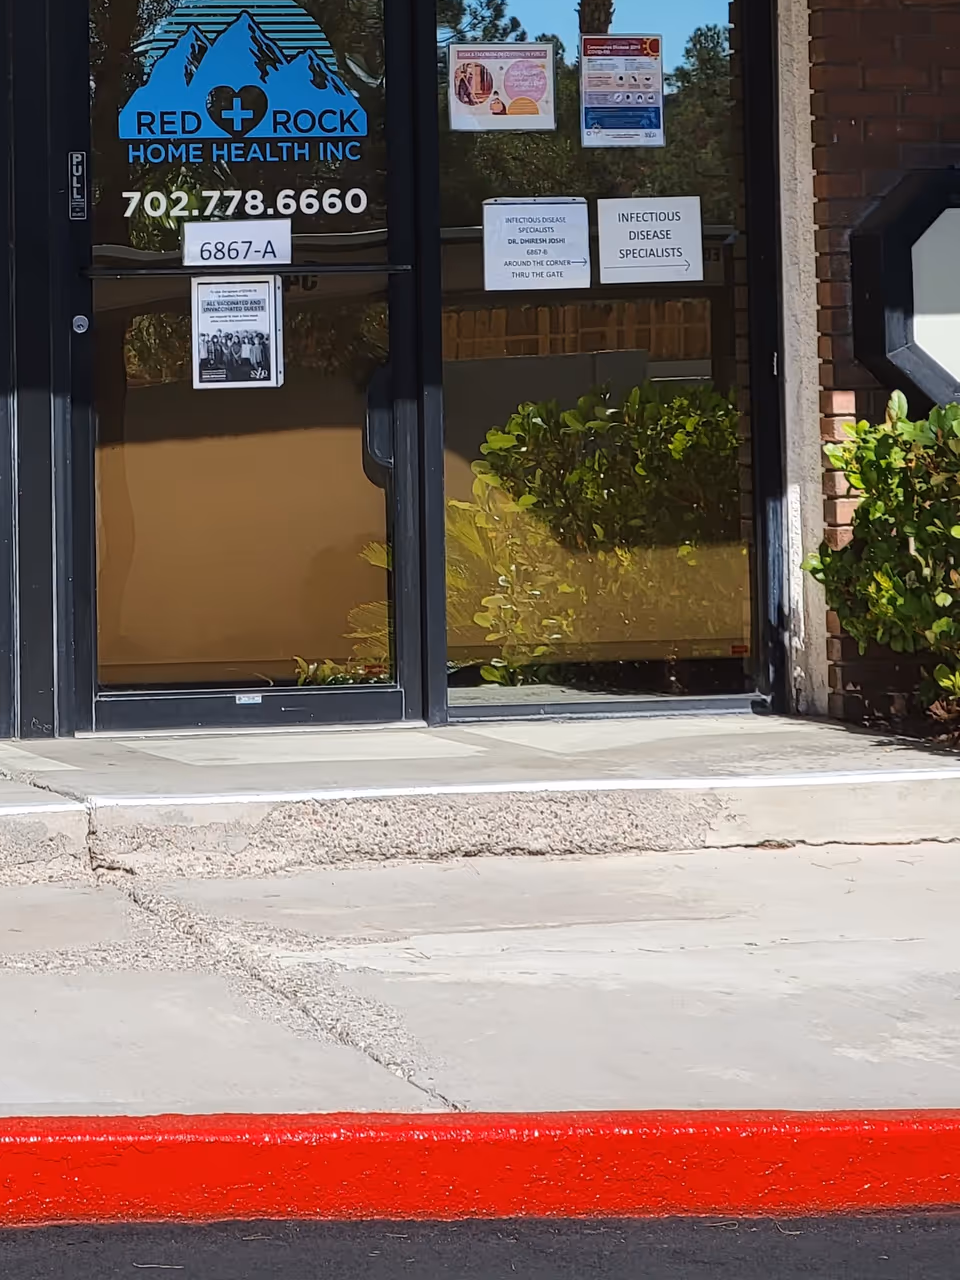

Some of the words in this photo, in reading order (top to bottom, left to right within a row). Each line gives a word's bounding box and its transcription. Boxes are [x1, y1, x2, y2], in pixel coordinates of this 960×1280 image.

[136, 110, 203, 136] RED
[272, 108, 359, 134] ROCK
[128, 142, 204, 163] HOME
[211, 142, 311, 162] HEALTH
[318, 141, 361, 162] INC
[72, 153, 83, 199] PULL
[121, 187, 368, 219] 702.778.6660
[618, 211, 681, 223] INFECTIOUS
[628, 229, 672, 241] DISEASE
[199, 240, 278, 262] 6867-A
[618, 247, 683, 259] SPECIALISTS
